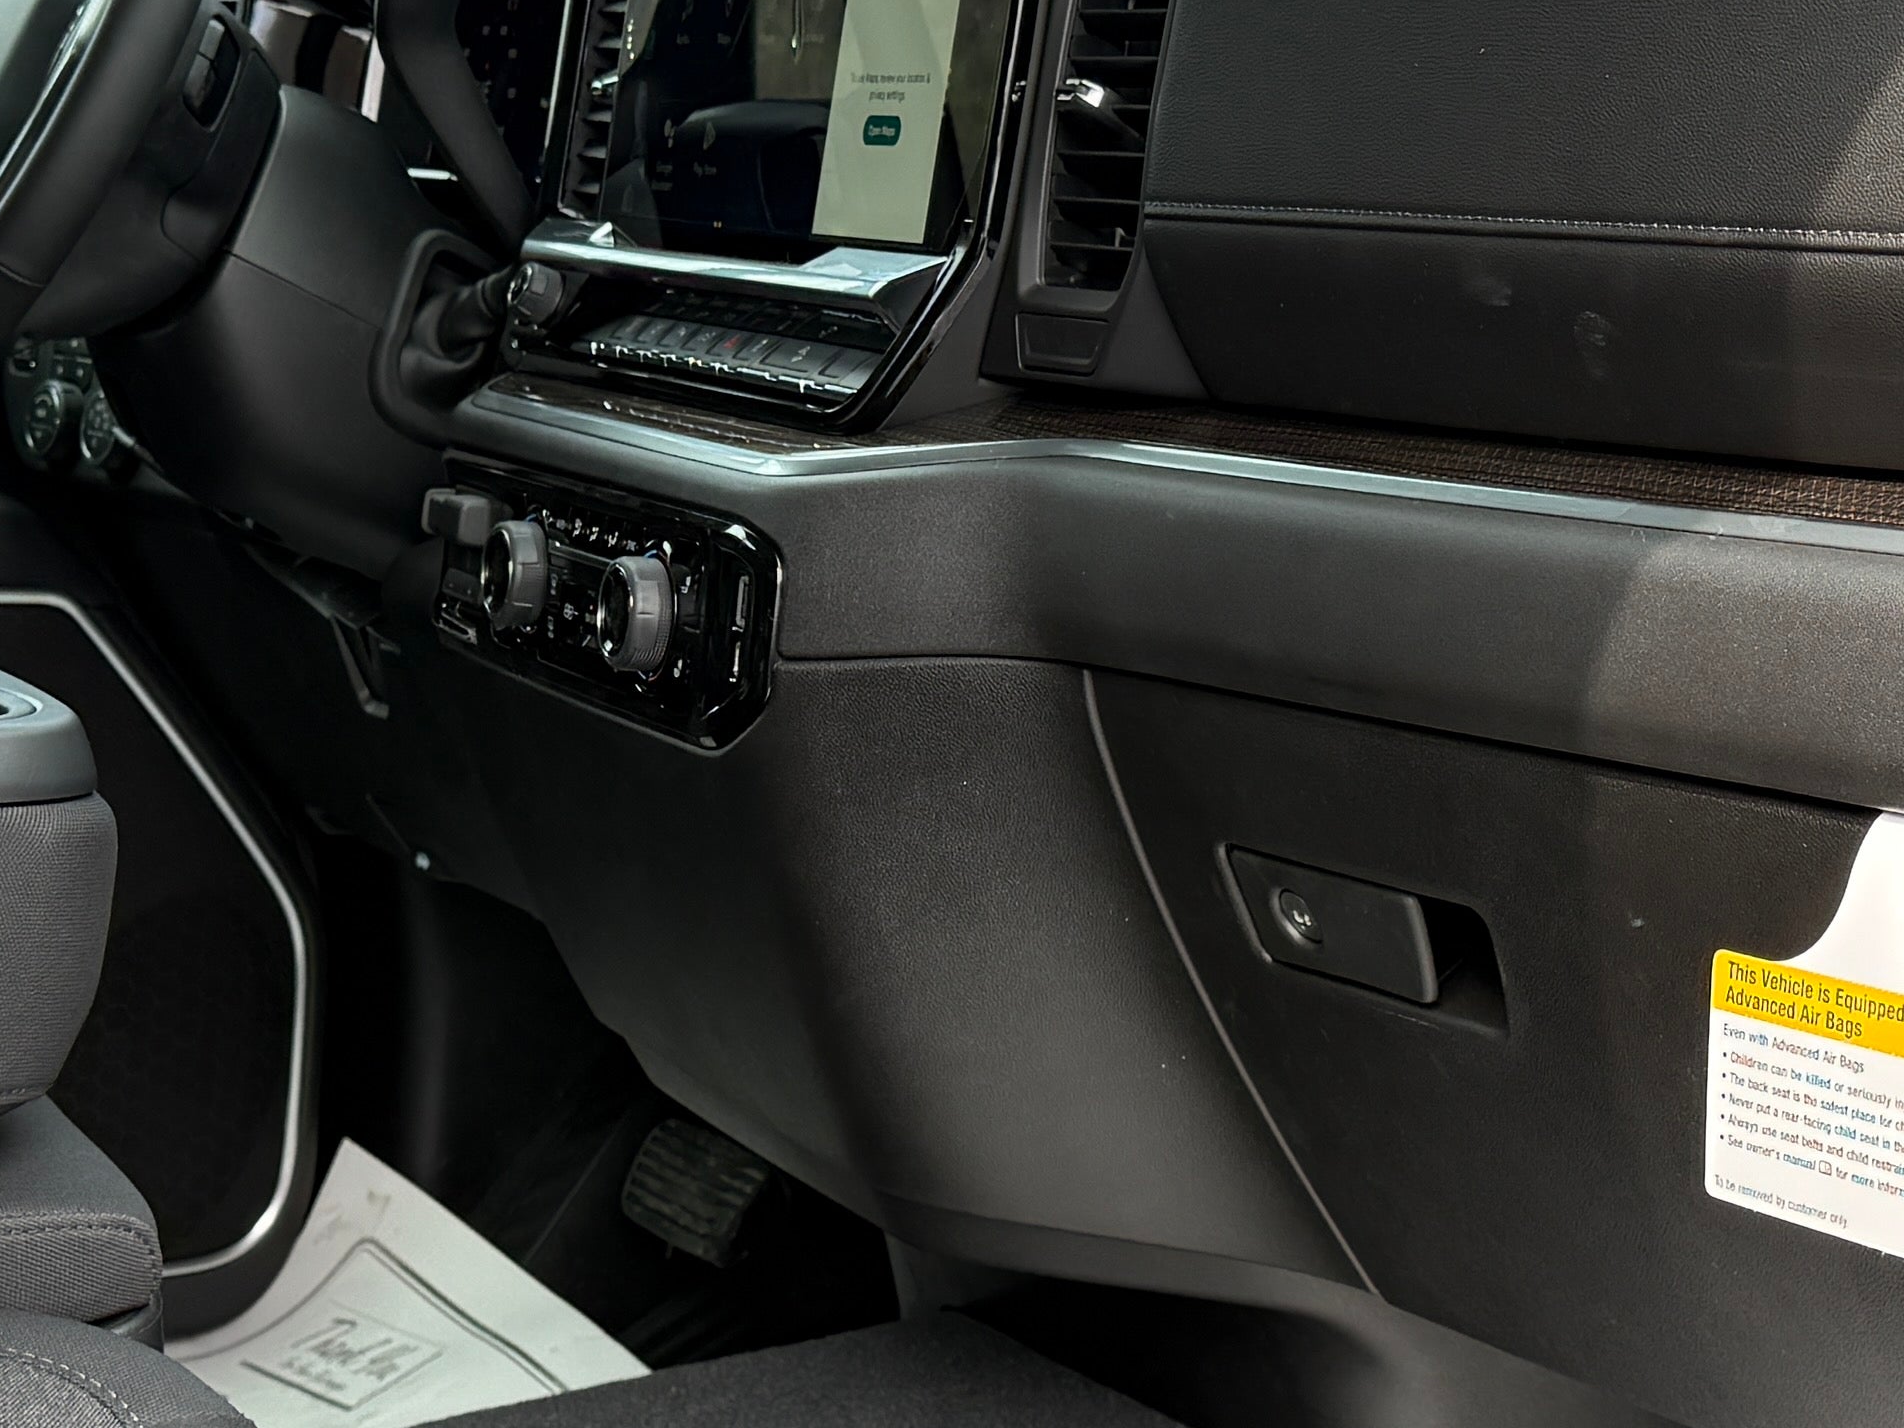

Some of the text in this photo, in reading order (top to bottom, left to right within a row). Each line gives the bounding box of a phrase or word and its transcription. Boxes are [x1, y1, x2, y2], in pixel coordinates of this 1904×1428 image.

[1726, 986, 1862, 1038] Advanced Air Bags
[1728, 961, 1757, 985] This
[1761, 969, 1813, 1000] Vehicle
[1818, 982, 1830, 1004] is
[1836, 988, 1904, 1024] Equipped
[1723, 1023, 1864, 1074] Even with Advanced Air Bags
